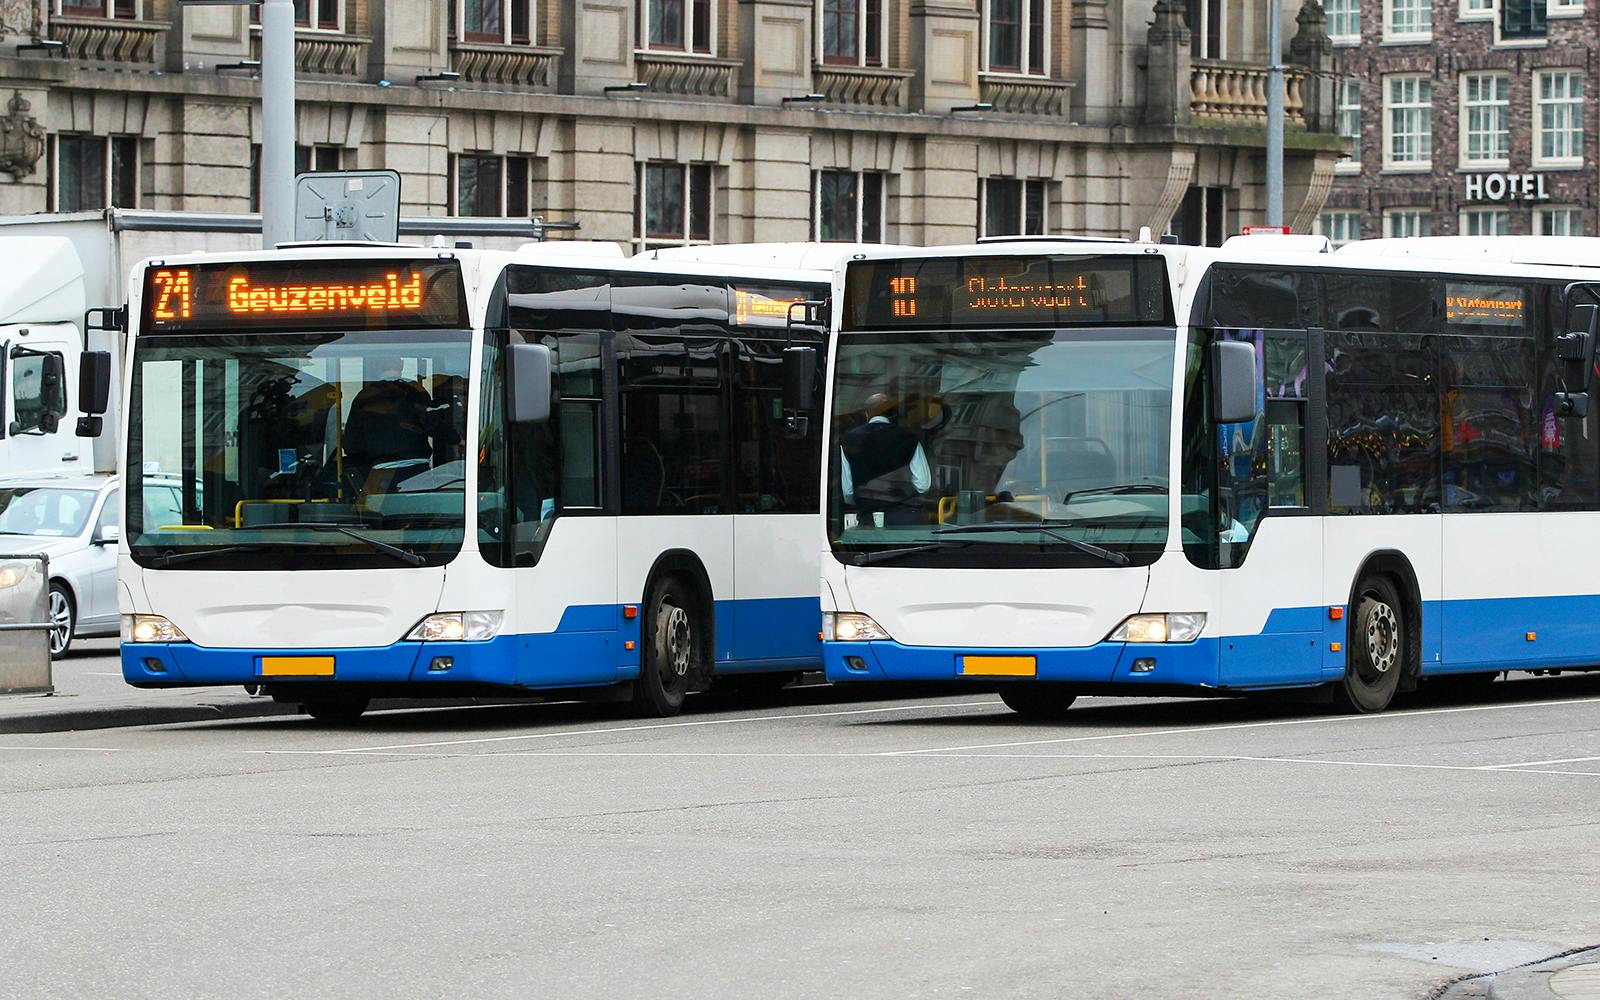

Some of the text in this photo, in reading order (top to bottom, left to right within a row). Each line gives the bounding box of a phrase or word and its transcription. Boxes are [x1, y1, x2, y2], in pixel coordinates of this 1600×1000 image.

[1465, 173, 1550, 200] HOTEL
[155, 271, 421, 318] 21 Geuzenveld
